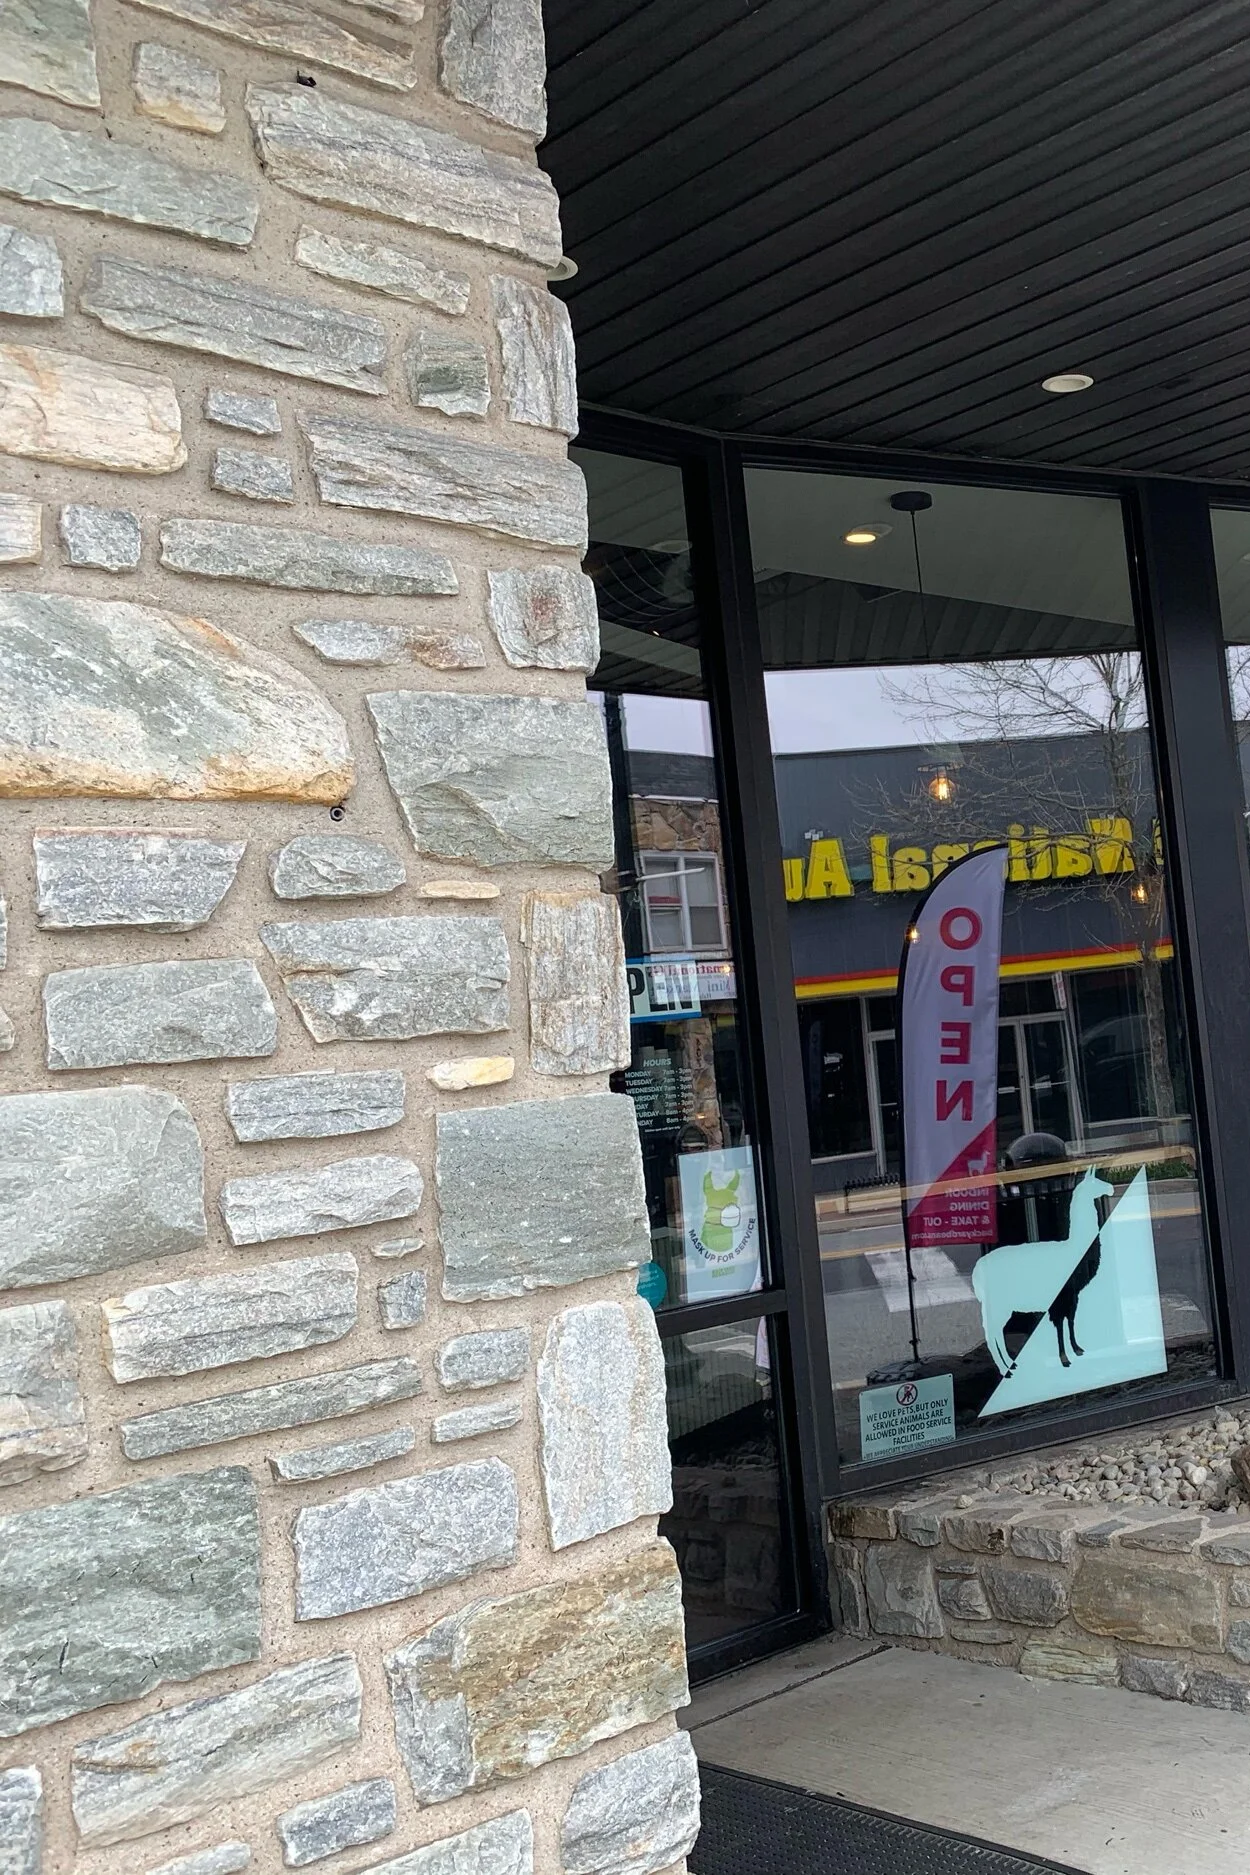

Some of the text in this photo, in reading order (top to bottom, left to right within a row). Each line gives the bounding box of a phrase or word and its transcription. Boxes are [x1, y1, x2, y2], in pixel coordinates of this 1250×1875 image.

[626, 966, 694, 1015] PEN
[643, 1058, 672, 1067] HOURS
[625, 1070, 652, 1078] MONDAY
[625, 1079, 654, 1087] TUESDAY
[626, 1086, 663, 1094] WEDNESDAY
[634, 1094, 659, 1102] URSDAY
[636, 1110, 659, 1118] TURDAY
[637, 1119, 654, 1127] NDAY
[688, 1217, 757, 1263] MASK UP FOR SERVICE
[866, 1413, 877, 1423] WE
[879, 1409, 896, 1421] LOVE
[916, 1403, 929, 1413] BUT
[931, 1398, 949, 1409] ONLY
[872, 1409, 944, 1431] SERVICE ANIMALS ARE
[865, 1416, 952, 1442] ALLOWED IN FOOD SERVICE
[893, 1432, 925, 1446] FACILITIES
